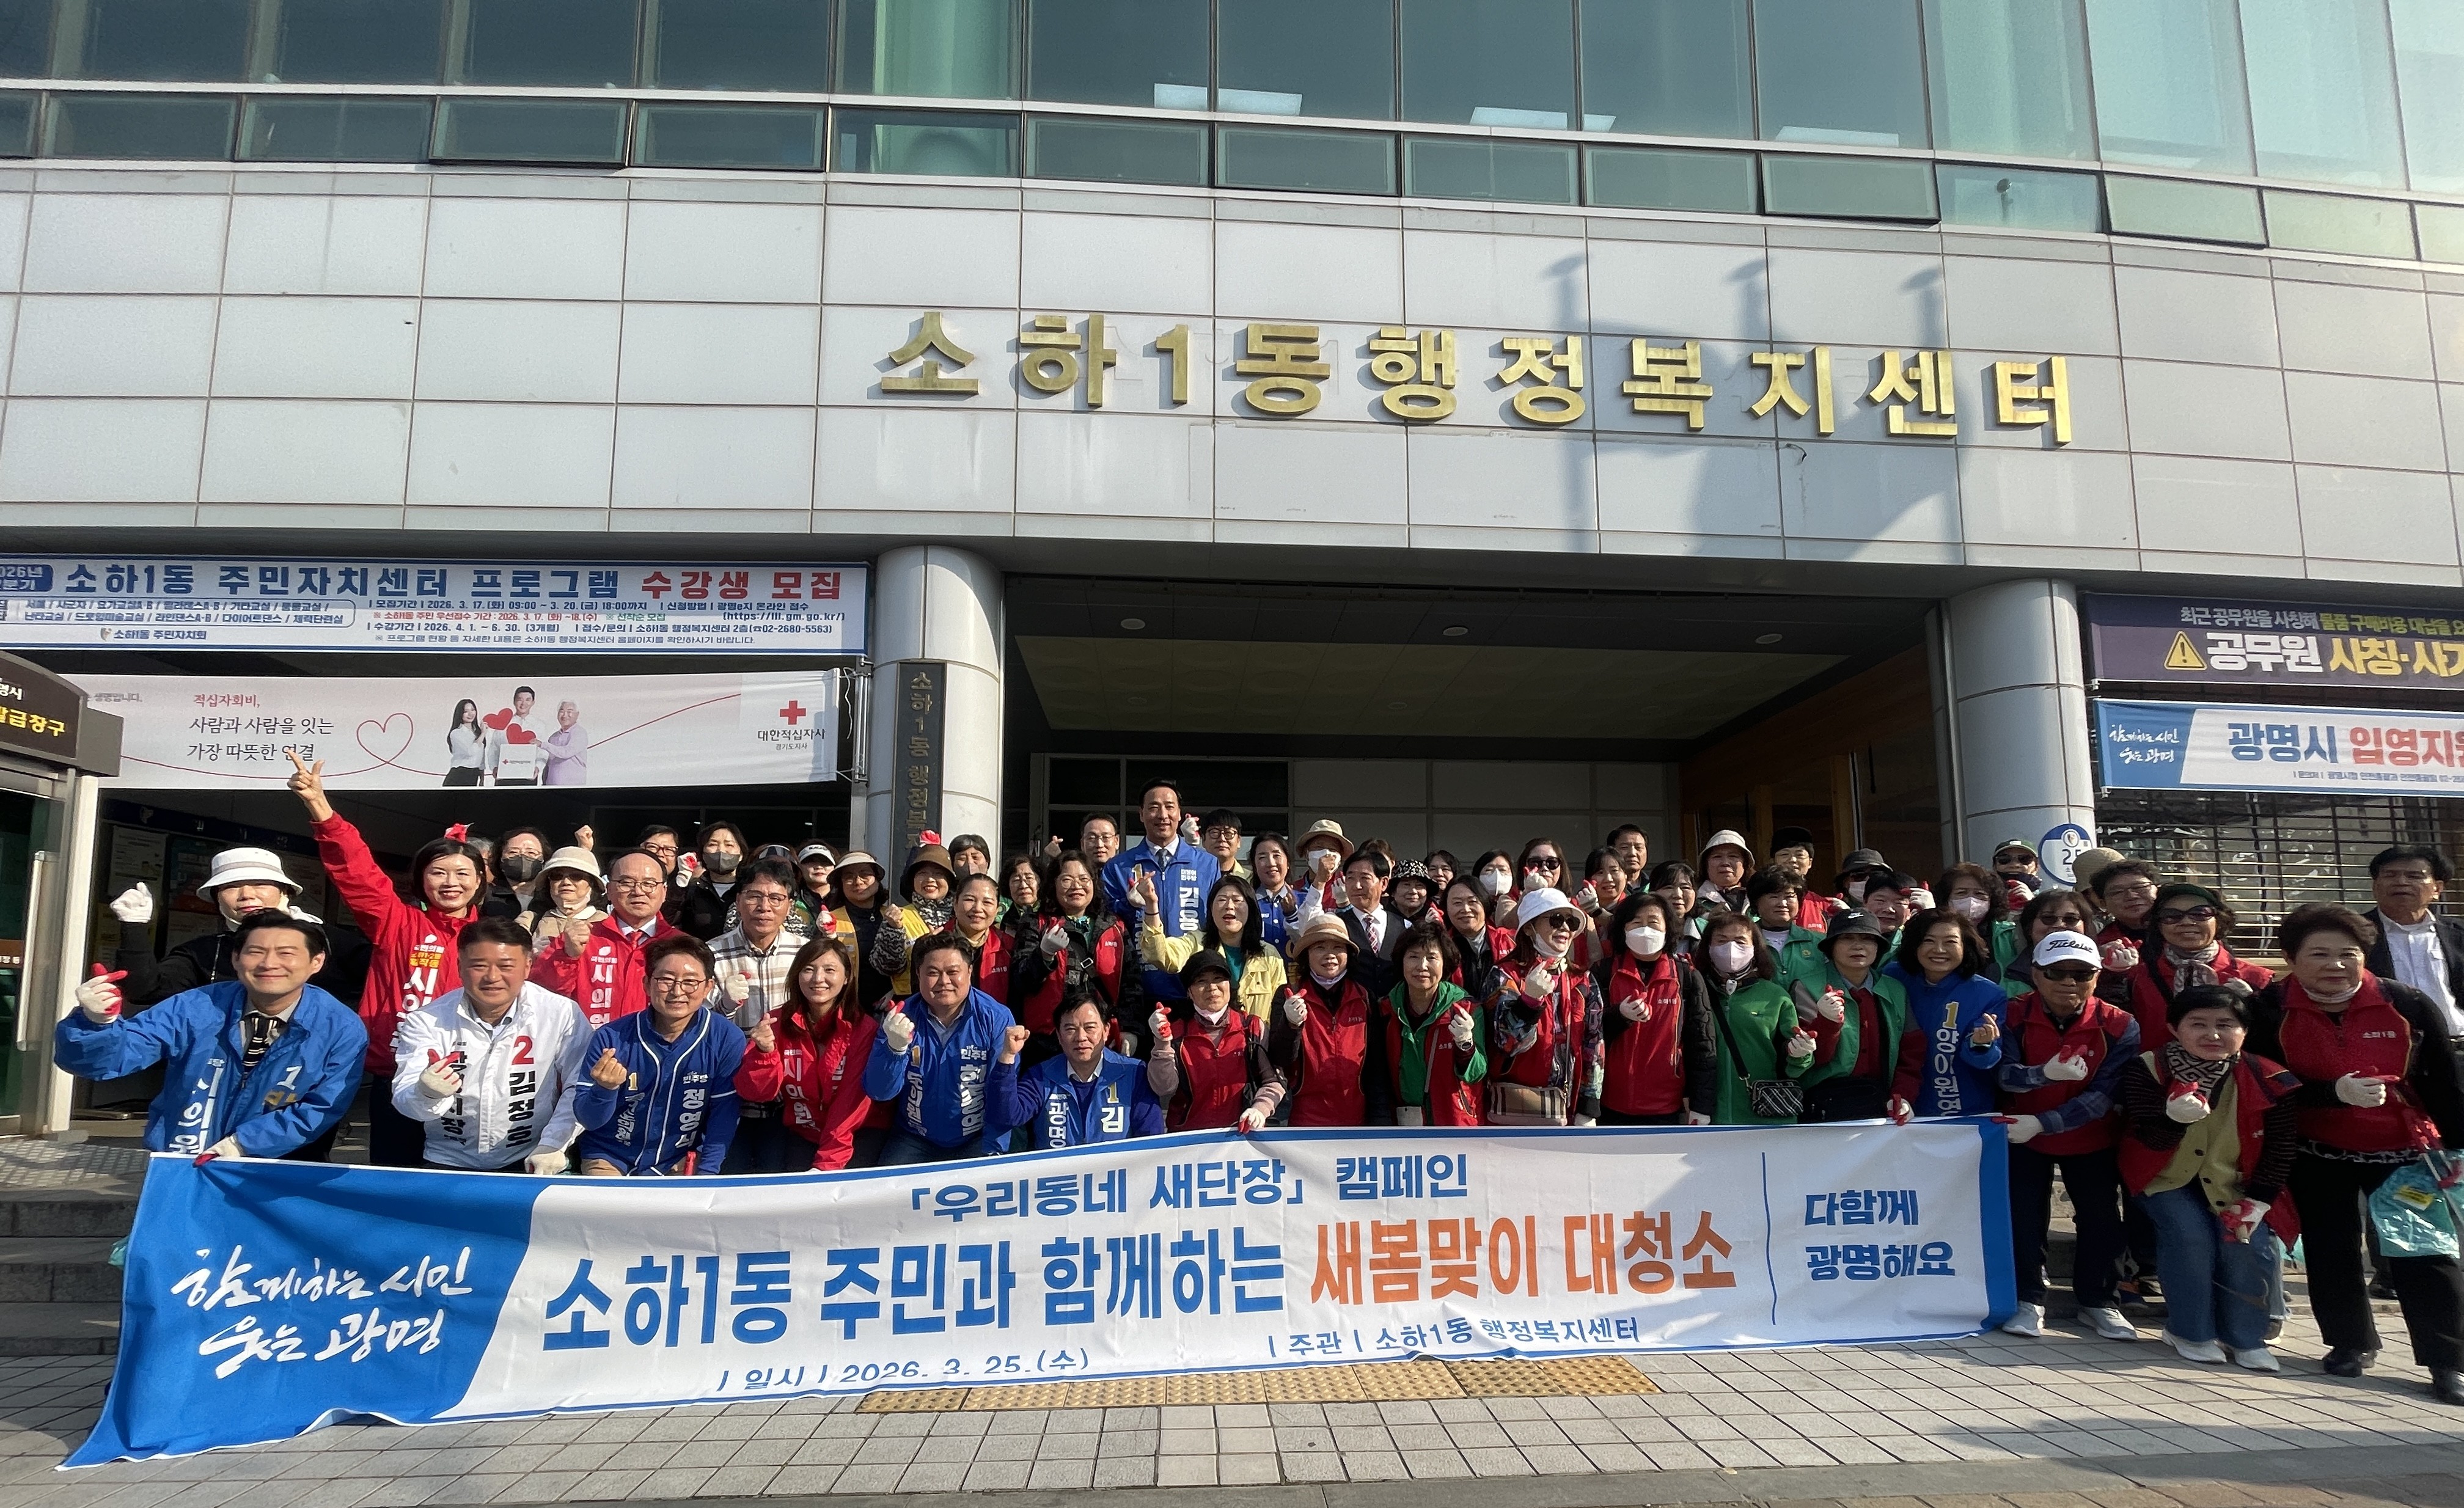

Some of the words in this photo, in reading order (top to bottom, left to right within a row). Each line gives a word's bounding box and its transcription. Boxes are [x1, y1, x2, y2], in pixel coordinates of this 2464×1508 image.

[881, 310, 2073, 446] 소하1동행정복지센터
[0, 579, 36, 590] 분기
[65, 564, 194, 594] 소하1동
[219, 566, 447, 597] 주민자치센터
[471, 569, 618, 598] 프로그램
[642, 571, 749, 599] 수강생
[771, 572, 841, 599] 모집
[376, 599, 417, 609] 모집기간
[2180, 606, 2212, 625] 최근
[2213, 607, 2273, 628] 공무원을
[2275, 610, 2320, 630] 사칭해
[374, 623, 414, 631] 수강기간
[2206, 632, 2324, 673] 공무원
[194, 694, 260, 708] 적십자회비,
[189, 716, 242, 734] 사람과
[244, 717, 296, 734] 사람을
[301, 717, 334, 734] 잇는
[757, 728, 825, 742] 대한적십자사
[2155, 728, 2180, 744] 시민
[186, 743, 222, 761] 가장
[226, 743, 277, 761] 따뜻한
[775, 742, 807, 751] 경기도지사
[2144, 748, 2174, 764] 광명
[2228, 722, 2339, 764] 광명시
[2349, 727, 2464, 767] 입영지
[1179, 887, 1200, 936] 김용
[2045, 939, 2094, 953] Titleist
[1942, 1001, 1960, 1030] 1
[512, 1035, 534, 1066] 2
[277, 1066, 302, 1091] 1
[628, 1072, 638, 1091] 1
[1107, 1082, 1120, 1104] 1
[1049, 1102, 1069, 1149] 광명
[1101, 1106, 1124, 1133] 김
[1336, 1154, 1468, 1201] 캠페인
[1804, 1189, 1920, 1226] 다함께
[380, 1246, 474, 1298] 시민
[1805, 1241, 1957, 1281] 광명해요
[543, 1251, 793, 1352] 소하1동
[820, 1240, 1017, 1341] 주민과
[1041, 1226, 1285, 1326] 함께하는
[1311, 1215, 1539, 1306] 새봄맞이
[1563, 1210, 1738, 1296] 대청소
[199, 1314, 308, 1380] 웃는
[314, 1306, 446, 1363] 광명
[1289, 1330, 1343, 1355] 주관
[1376, 1316, 1474, 1349] 소하1동
[1481, 1316, 1641, 1344] 행정복지센터
[745, 1364, 805, 1391] 일시
[839, 1360, 929, 1383] 2026.
[943, 1358, 970, 1376] 3.
